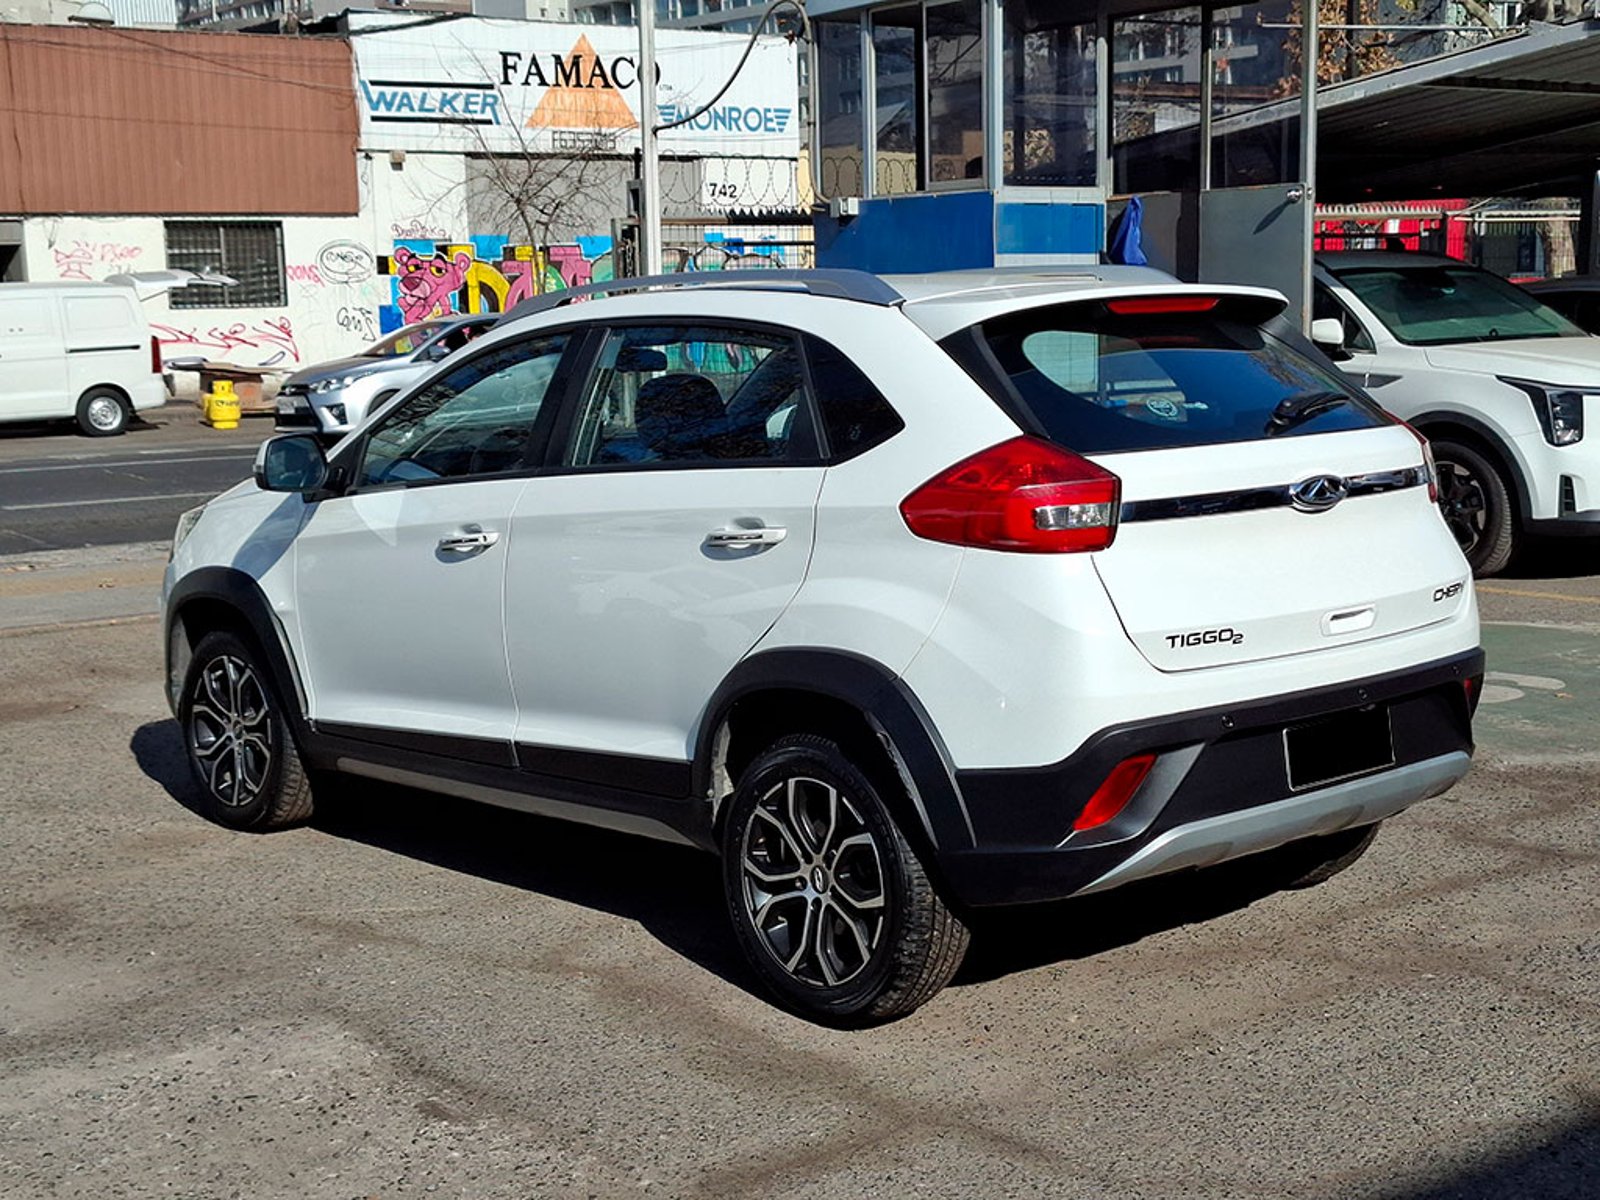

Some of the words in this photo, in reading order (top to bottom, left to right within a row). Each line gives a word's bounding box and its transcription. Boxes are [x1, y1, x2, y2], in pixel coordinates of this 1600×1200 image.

[360, 80, 500, 125] WALKER
[675, 104, 777, 132] MONROE
[709, 183, 737, 199] 742
[1165, 628, 1244, 648] TIGGO2
